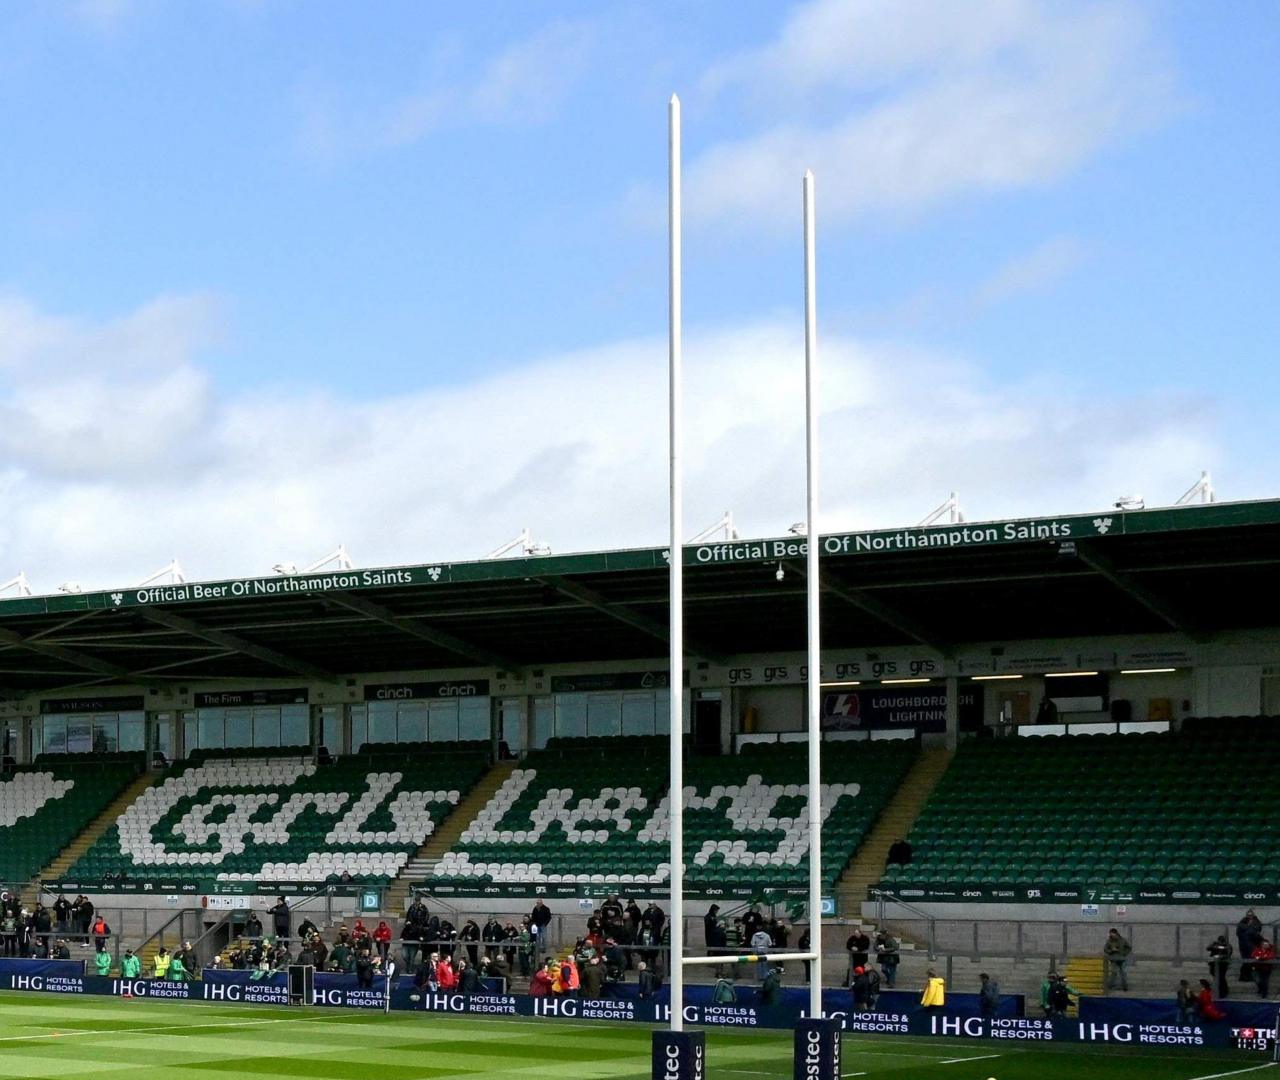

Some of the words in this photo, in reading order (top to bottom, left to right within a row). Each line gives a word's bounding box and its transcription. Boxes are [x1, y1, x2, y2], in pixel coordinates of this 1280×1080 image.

[696, 543, 767, 562] Official
[774, 540, 808, 556] Bee
[825, 536, 853, 553] Of
[856, 526, 998, 554] Northampton
[1004, 518, 1070, 540] Saints
[137, 586, 190, 604] Official
[194, 584, 228, 600] Beer
[232, 581, 250, 596] Of
[254, 574, 359, 596] Northampton
[362, 570, 412, 586] Saints
[729, 668, 751, 683] grs
[764, 666, 787, 681] grs
[836, 663, 860, 678] grs
[872, 661, 896, 676] grs
[910, 659, 935, 674] grs
[376, 688, 412, 698] cinch
[440, 684, 476, 696] cinch
[203, 695, 220, 704] The
[222, 694, 242, 704] Firm
[890, 711, 945, 722] LIGHTNIN
[204, 984, 240, 1000] IHG
[245, 994, 288, 1002] RESORTS
[534, 998, 576, 1016] IHG
[583, 1000, 623, 1009] HOTELS
[628, 1002, 634, 1010] &
[582, 1009, 634, 1019] RESORTS
[932, 1016, 983, 1036] IHG
[992, 1019, 1040, 1028] HOTELS
[1044, 1021, 1052, 1029] &
[1140, 1025, 1190, 1034] HOTELS
[991, 1030, 1052, 1040] RESORTS
[1079, 1022, 1132, 1042] IHG
[1140, 1034, 1202, 1044] RESORTS
